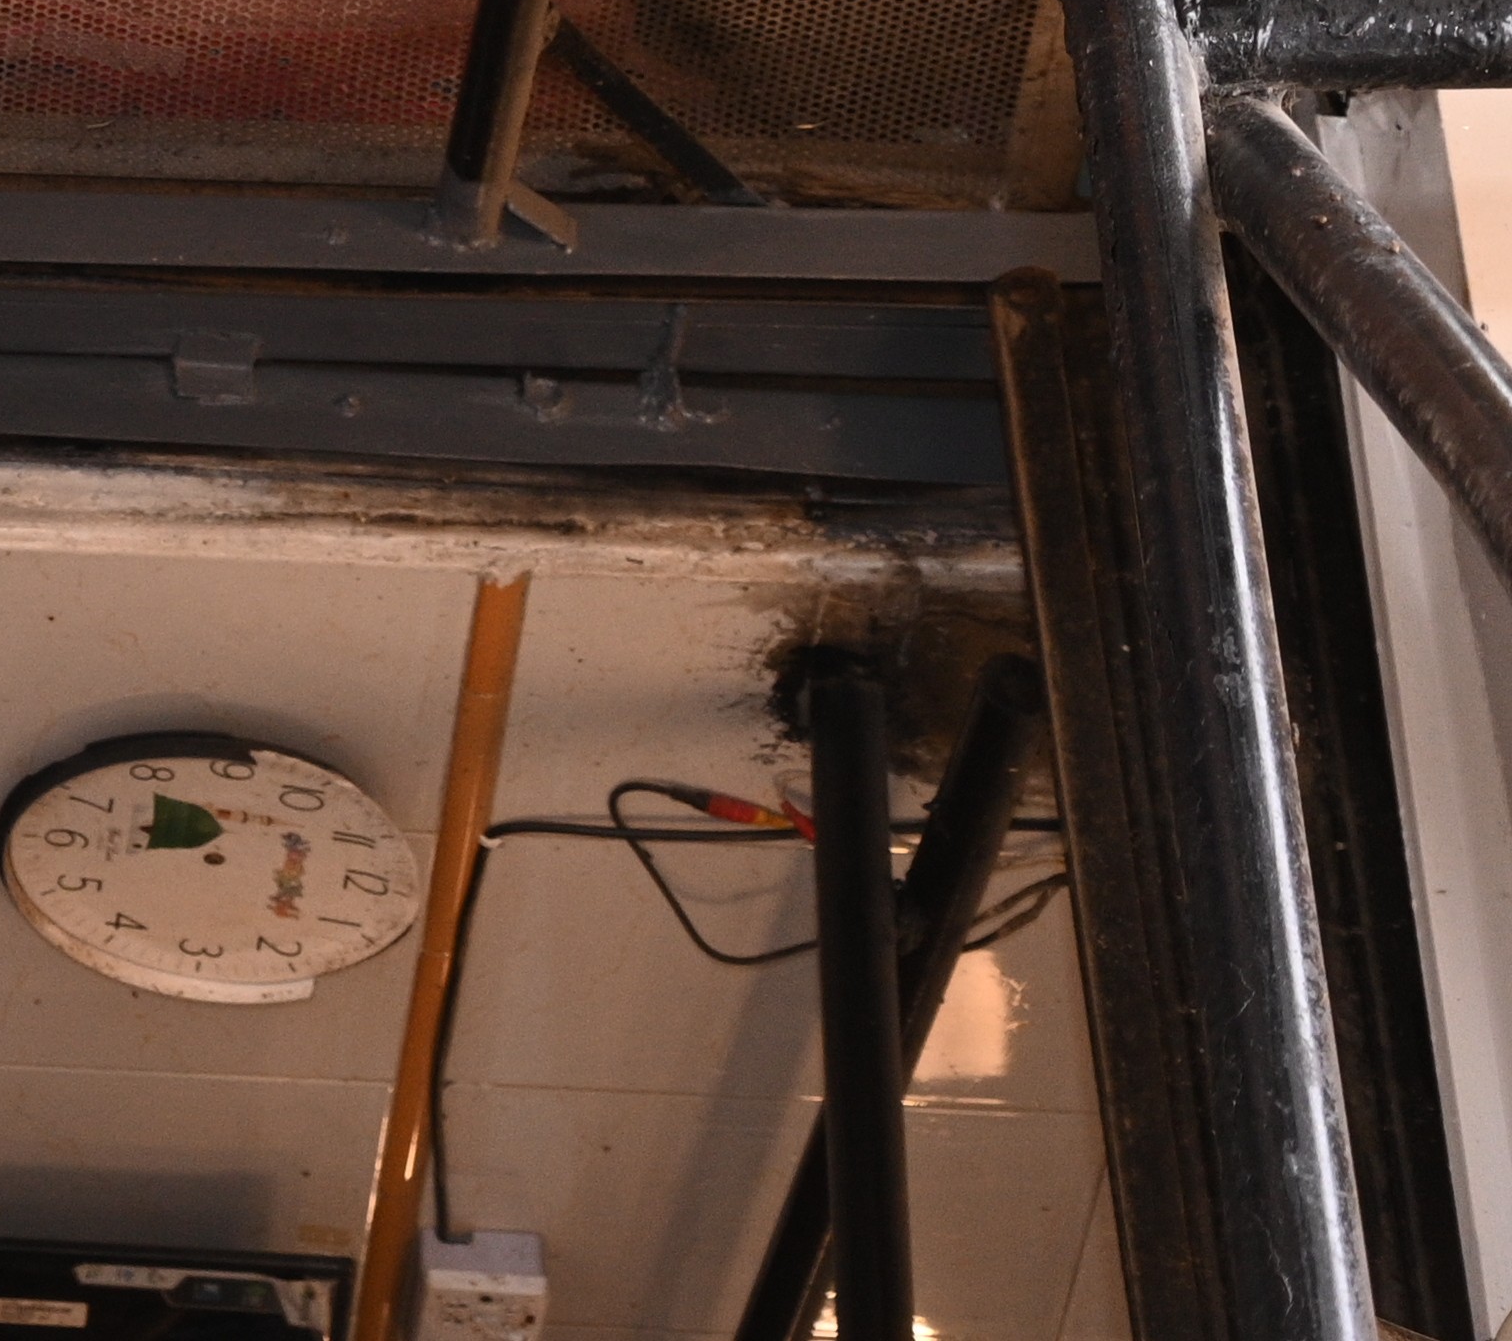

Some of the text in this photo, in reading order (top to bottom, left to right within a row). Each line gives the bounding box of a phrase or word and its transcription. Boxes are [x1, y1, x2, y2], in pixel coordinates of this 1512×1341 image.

[129, 763, 174, 782] 8
[210, 761, 254, 781] 9
[69, 795, 114, 814] 7
[279, 785, 325, 812] 10
[44, 829, 89, 847] 6
[332, 831, 375, 849] 11
[57, 874, 103, 892] 5
[343, 868, 390, 896] 12
[105, 913, 149, 930] 4
[317, 917, 362, 928] 1
[178, 939, 224, 959] 3
[256, 937, 303, 957] 2
